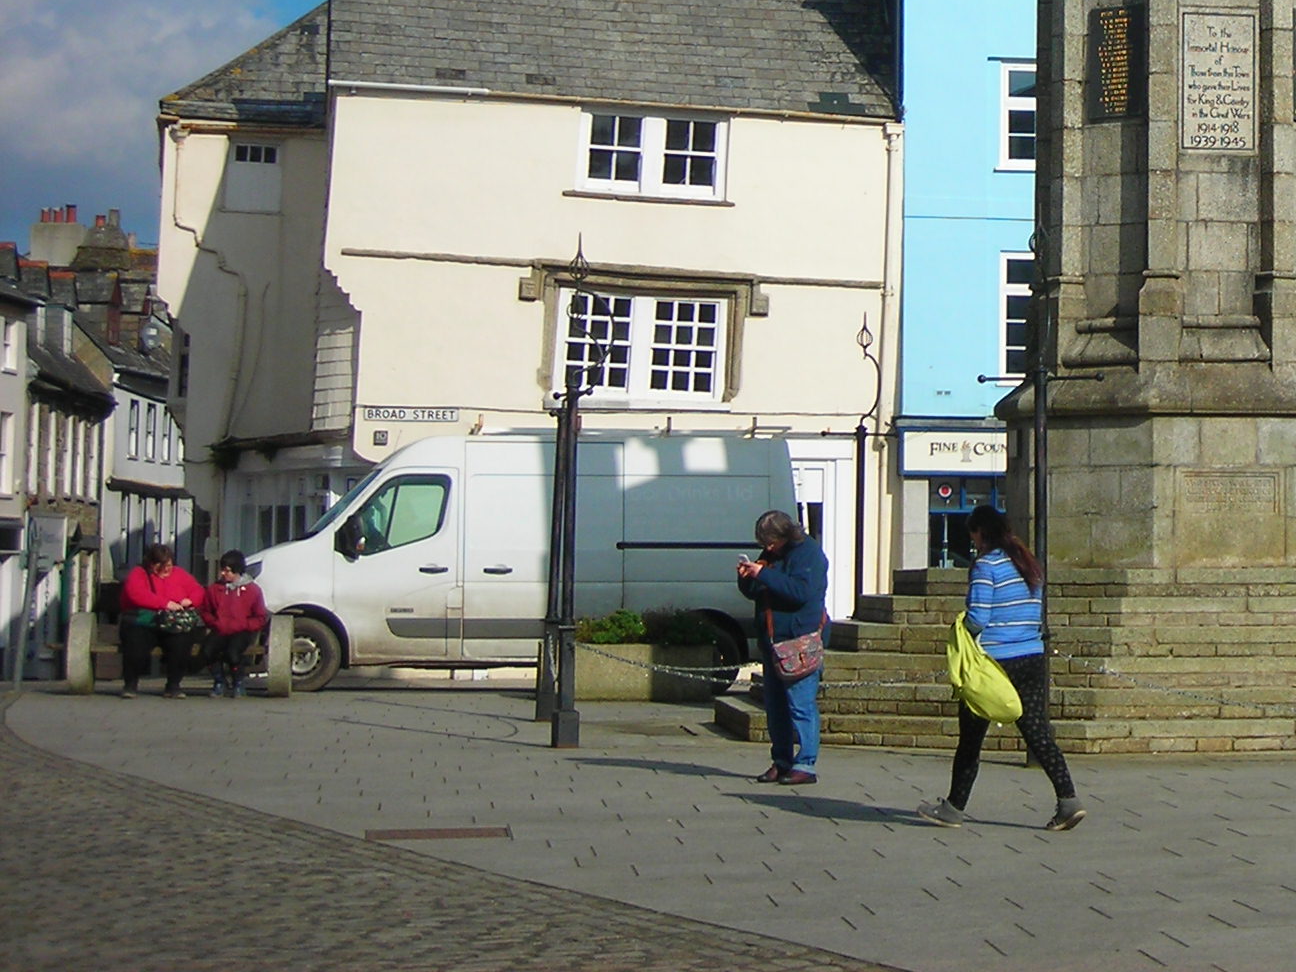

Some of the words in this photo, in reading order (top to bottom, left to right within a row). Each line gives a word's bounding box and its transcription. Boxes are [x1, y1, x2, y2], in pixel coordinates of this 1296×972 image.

[1207, 26, 1217, 37] To
[1220, 28, 1232, 38] the
[1214, 55, 1224, 65] of
[1232, 65, 1250, 77] Town
[1188, 80, 1201, 89] who
[1202, 83, 1217, 92] gave
[1231, 80, 1250, 91] Lives
[1187, 94, 1197, 104] for
[1198, 94, 1215, 108] King
[1216, 94, 1223, 105] &
[1223, 94, 1249, 109] Country
[1199, 108, 1208, 119] the
[367, 409, 406, 419] BROAD
[413, 410, 455, 420] STREET
